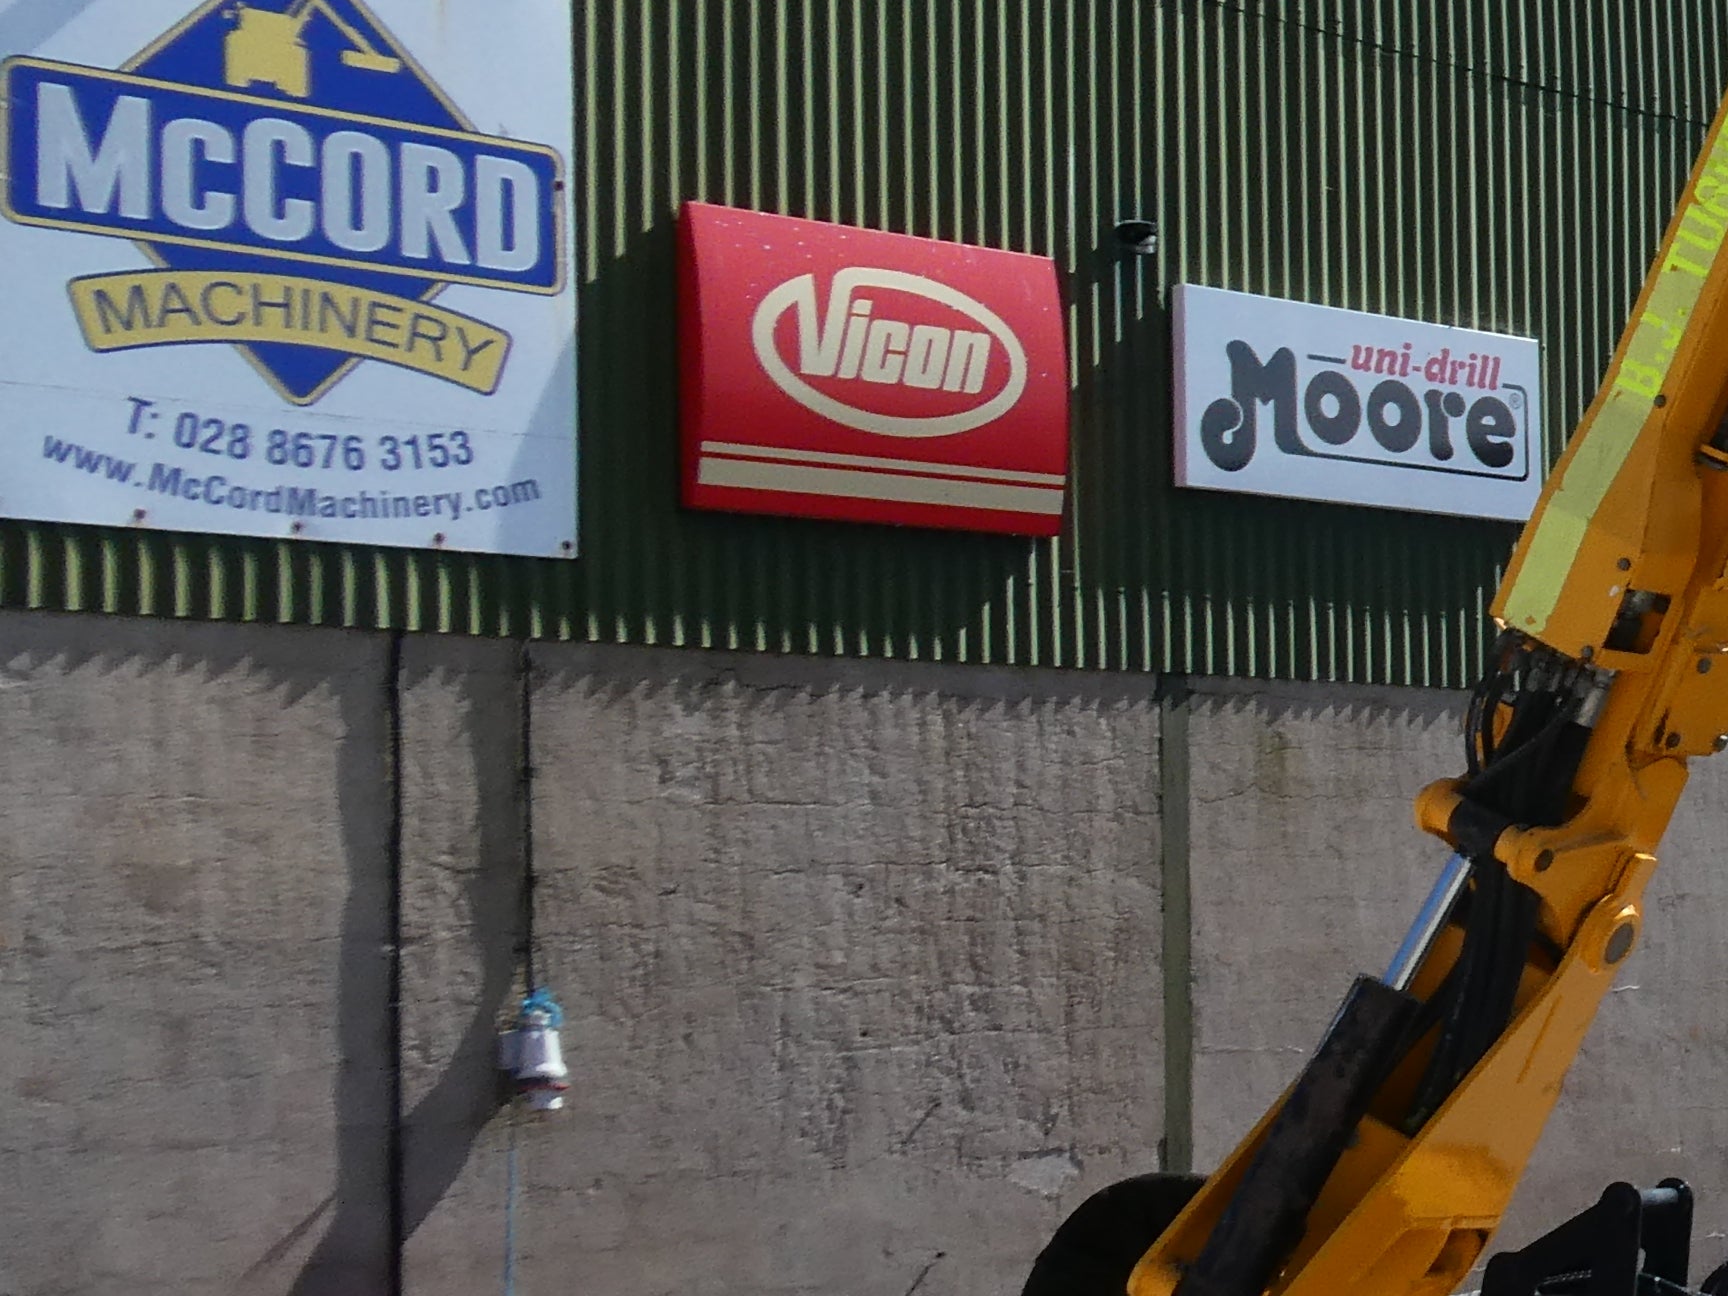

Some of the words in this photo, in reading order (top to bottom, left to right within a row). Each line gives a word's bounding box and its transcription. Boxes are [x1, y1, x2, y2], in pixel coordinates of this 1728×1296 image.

[92, 281, 496, 371] MACHINERY
[796, 268, 991, 394] Vicon
[1351, 342, 1501, 390] uni-drill
[126, 396, 159, 439] T:
[174, 412, 251, 460] 028
[266, 429, 365, 471] 8676
[378, 430, 474, 471] 3153
[1202, 339, 1516, 472] Moore
[43, 435, 542, 520] www.McCordMachinery.com
